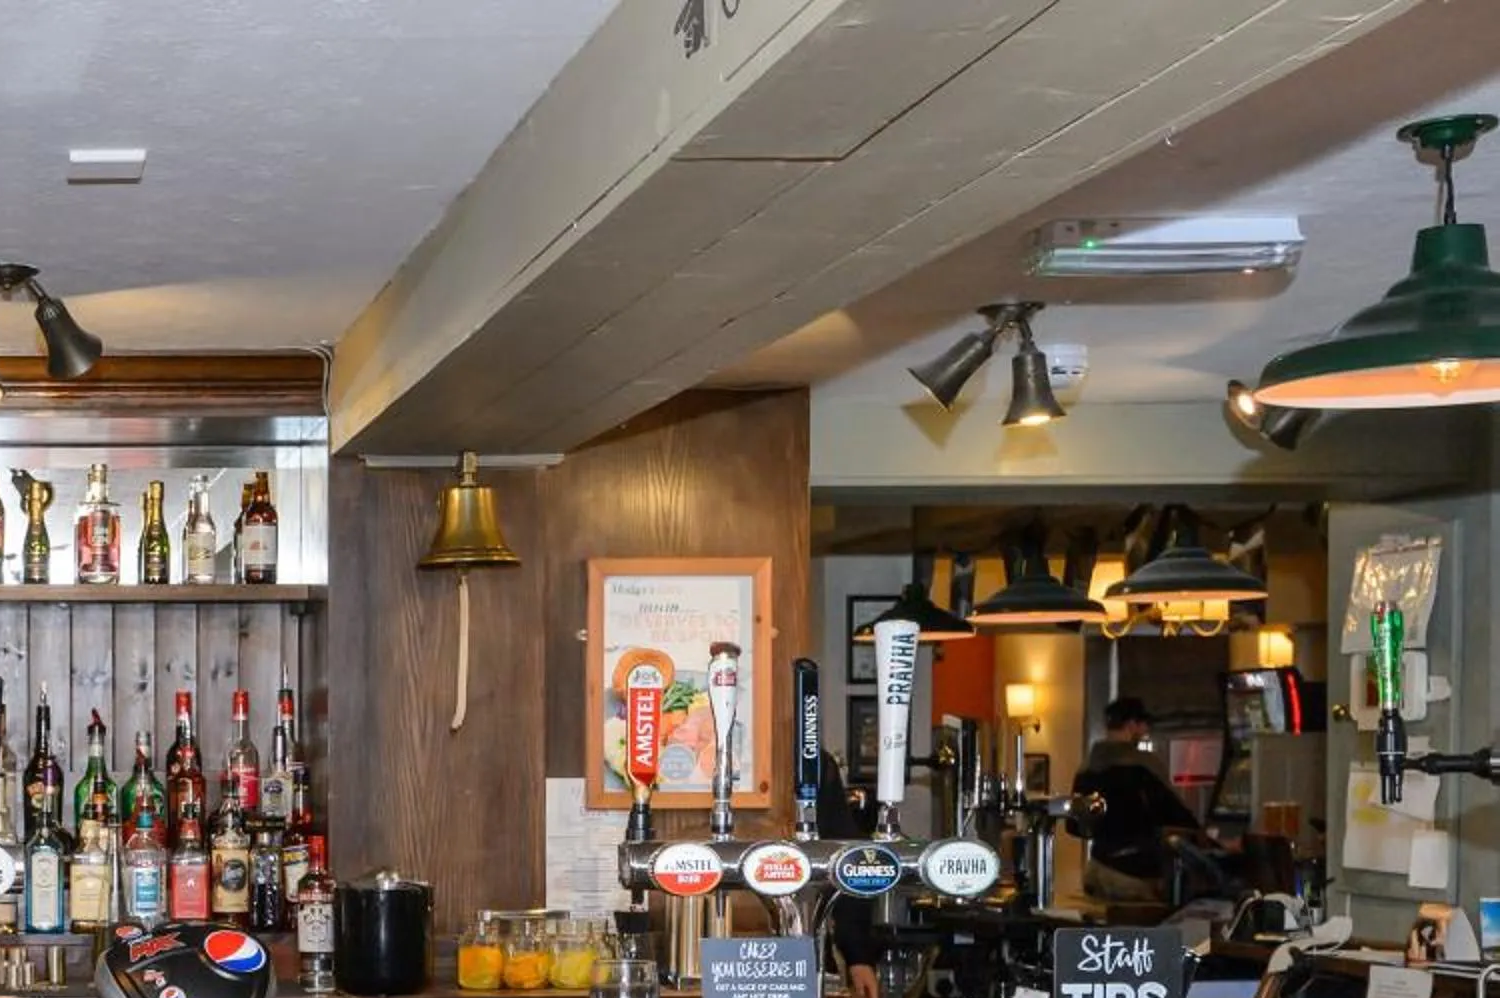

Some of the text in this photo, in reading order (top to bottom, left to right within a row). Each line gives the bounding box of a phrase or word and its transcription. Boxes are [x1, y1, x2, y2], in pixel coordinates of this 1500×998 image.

[886, 632, 915, 705] PRAVHA
[635, 688, 655, 767] AMSTEL
[803, 694, 818, 759] GUINNESS
[843, 864, 896, 877] GUINNESS
[1077, 933, 1155, 977] Staff
